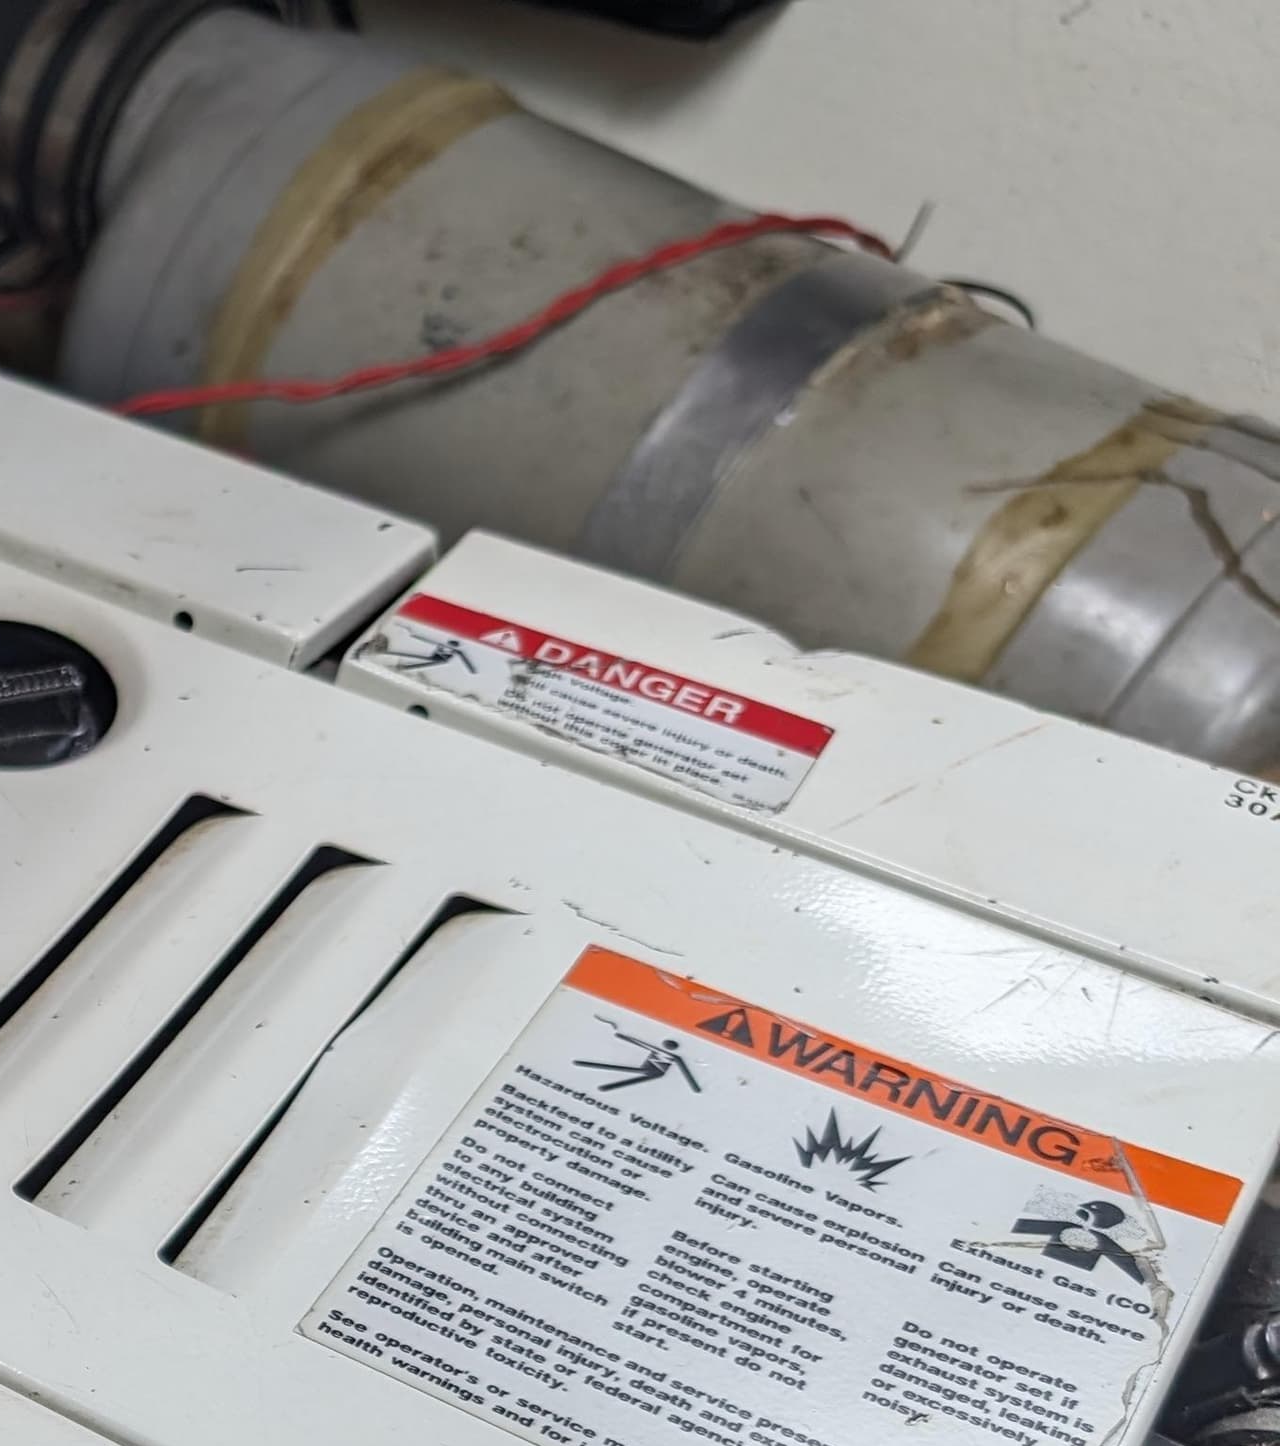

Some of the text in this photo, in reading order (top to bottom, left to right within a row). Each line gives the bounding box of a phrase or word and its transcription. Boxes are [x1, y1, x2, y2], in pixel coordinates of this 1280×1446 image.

[496, 698, 559, 724] without
[534, 640, 744, 724] DANGER
[549, 689, 710, 752] cause severe injury
[633, 737, 717, 771] generator
[500, 1083, 694, 1173] Backfeed to a utility
[515, 1064, 708, 1153] Hazardous Voltage.
[767, 1022, 1082, 1167] WARNING
[460, 1135, 614, 1211] Do not connect
[473, 1118, 650, 1201] property damage.
[484, 1106, 642, 1179] electrocution or
[493, 1095, 673, 1178] system can cause
[435, 1173, 629, 1268] without connecting
[442, 1161, 614, 1244] electrical system
[452, 1148, 599, 1222] to any building
[694, 1196, 757, 1229] injury.
[710, 1173, 926, 1263] Can cause explosion
[723, 1152, 903, 1228] Gasoline Vapors.
[395, 1220, 498, 1276] is opened.
[404, 1207, 608, 1306] building main switch
[414, 1198, 583, 1277] device and after
[424, 1184, 600, 1269] thru an approved
[670, 1229, 834, 1304] Before starting
[700, 1186, 917, 1274] and severe personal
[646, 1269, 792, 1334] check engine
[653, 1254, 847, 1342] blower 4 minutes,
[662, 1244, 831, 1316] engine, operate
[937, 1260, 1145, 1342] Can cause severe
[949, 1237, 1044, 1279] Exhaust
[1051, 1274, 1097, 1297] Gas
[366, 1259, 452, 1306] damage,
[456, 1302, 553, 1349] personal
[555, 1343, 620, 1382] injury,
[628, 1378, 693, 1411] death
[698, 1409, 744, 1433] and
[377, 1246, 479, 1301] Operation,
[483, 1297, 621, 1363] maintenance
[623, 1359, 668, 1383] and
[669, 1379, 753, 1420] service
[611, 1320, 669, 1351] start.
[620, 1303, 807, 1390] if present do not
[629, 1295, 806, 1376] gasoline vapors,
[637, 1282, 823, 1362] compartment for
[929, 1272, 1106, 1344] injury or death.
[316, 1320, 387, 1358] health
[390, 1355, 485, 1405] warnings
[490, 1404, 535, 1428] and
[539, 1424, 573, 1444] for
[327, 1308, 368, 1333] See
[373, 1331, 479, 1385] operator's
[485, 1383, 510, 1397] or
[515, 1397, 597, 1438] service
[870, 1377, 897, 1391] or
[878, 1363, 991, 1414] damaged,
[885, 1345, 1094, 1433] exhaust system is
[892, 1335, 1079, 1410] generator set if
[901, 1320, 1078, 1393] Do not operate
